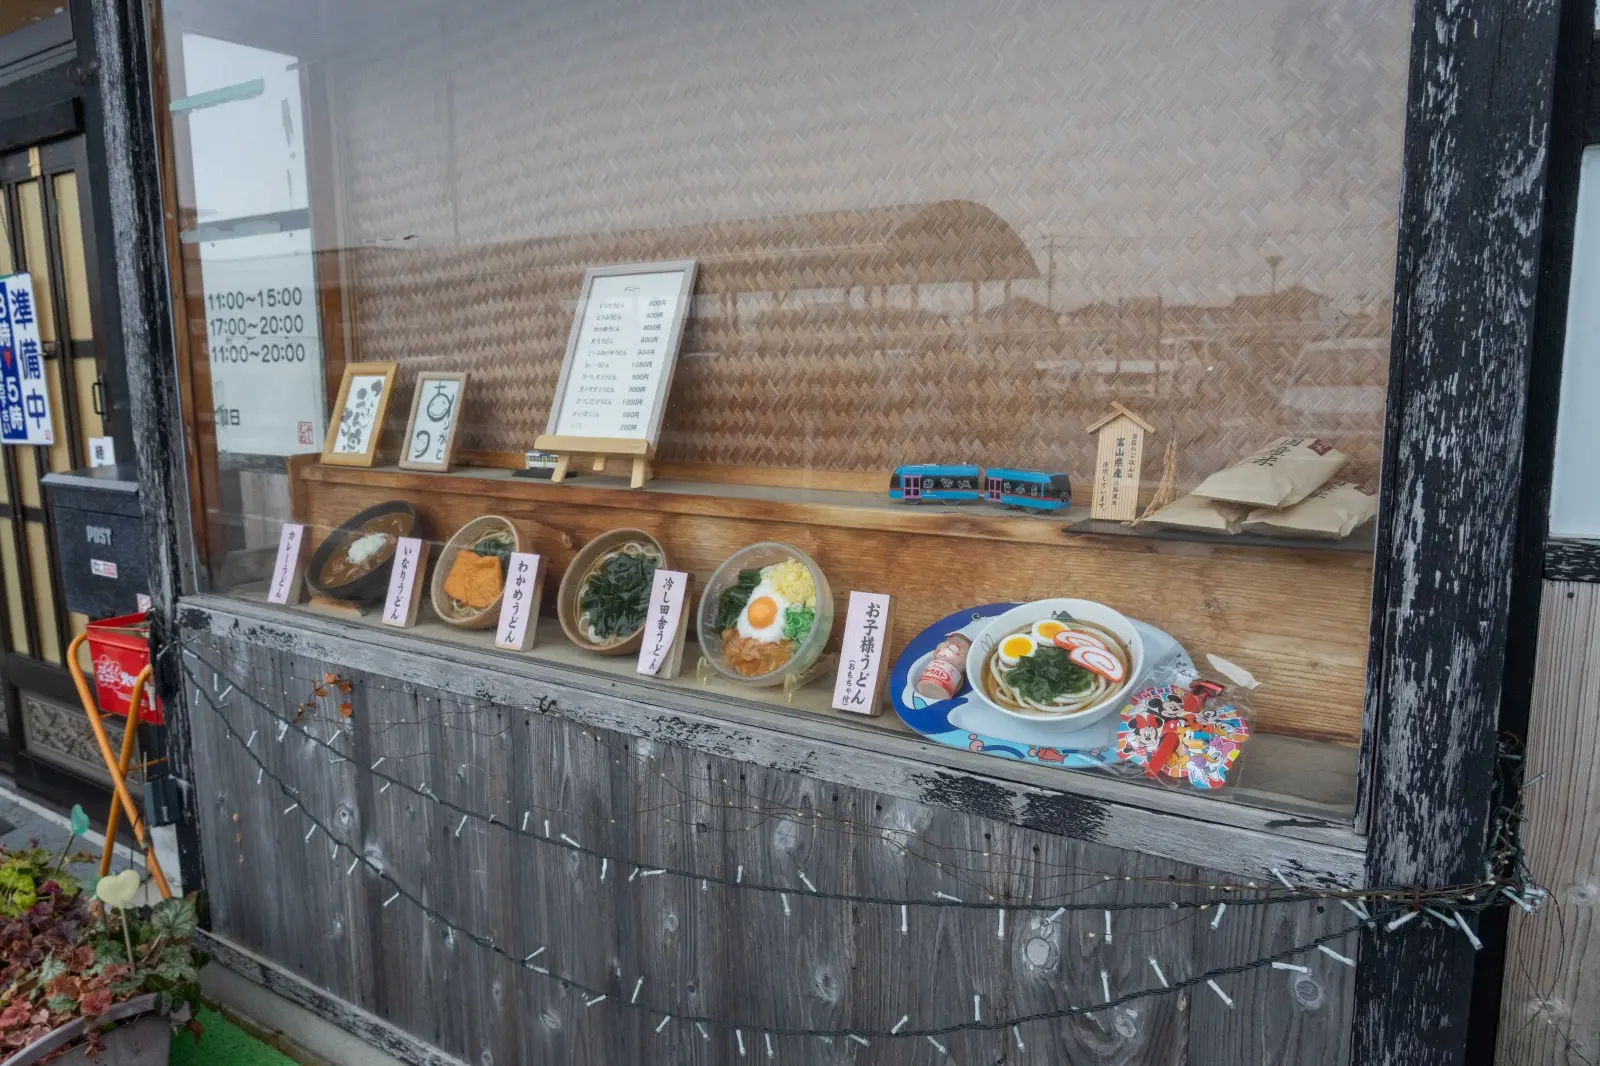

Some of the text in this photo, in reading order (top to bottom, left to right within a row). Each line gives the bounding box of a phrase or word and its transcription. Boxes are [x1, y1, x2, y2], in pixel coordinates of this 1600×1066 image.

[207, 286, 303, 311] 11:00~15:00
[209, 314, 304, 337] 17:00~20:00
[10, 287, 47, 430] 準備中
[211, 343, 306, 364] 11:00~20:00
[86, 525, 113, 546] POST
[275, 530, 296, 599] カレーうどん
[390, 546, 412, 621] いなりうどん
[504, 560, 529, 644] わかめうどん
[648, 577, 676, 671] 冷し田舎うどん
[851, 602, 881, 705] お子様うどん
